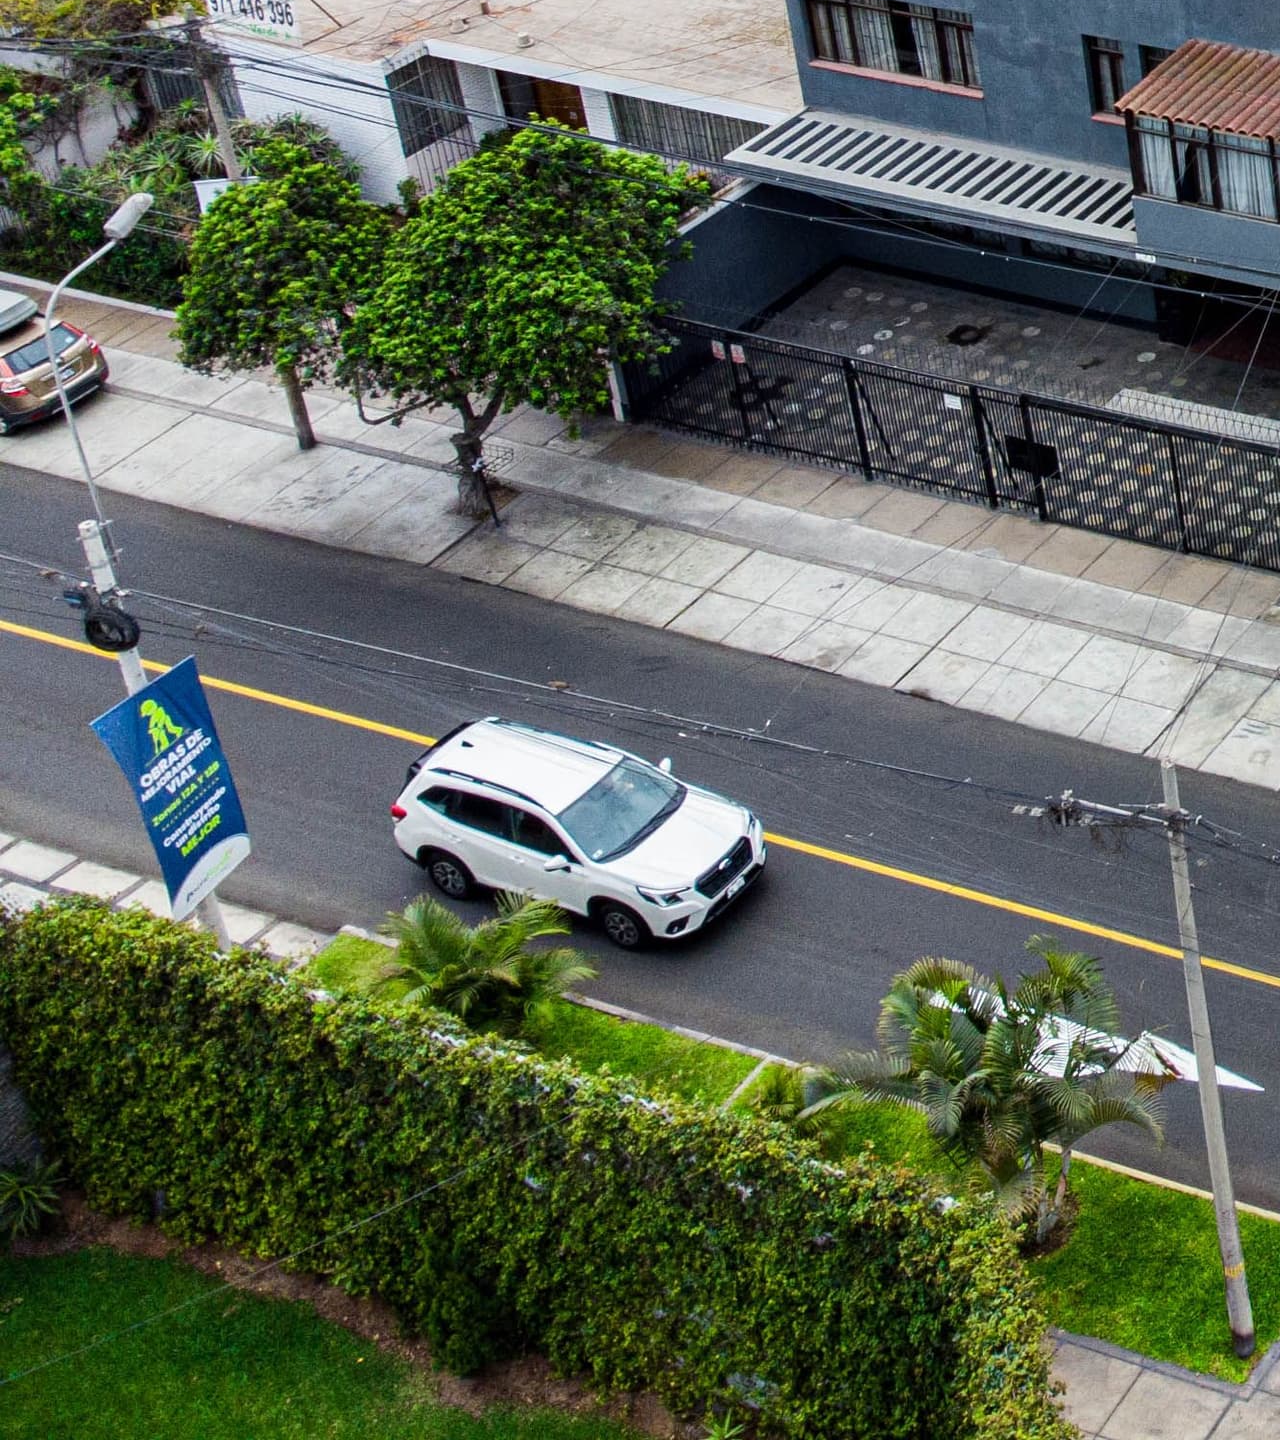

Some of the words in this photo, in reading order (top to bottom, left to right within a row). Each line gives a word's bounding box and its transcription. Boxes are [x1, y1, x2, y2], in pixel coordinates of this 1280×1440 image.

[267, 0, 293, 27] 396
[140, 743, 186, 788] OBRAS
[185, 728, 204, 750] DE
[141, 737, 212, 803] MEJORAMIENTO
[165, 764, 197, 794] VIAL
[152, 798, 182, 827] Zonas
[163, 786, 226, 848] Construyendo
[175, 833, 189, 848] un
[188, 803, 220, 835] distrito
[181, 814, 221, 857] MEJOR
